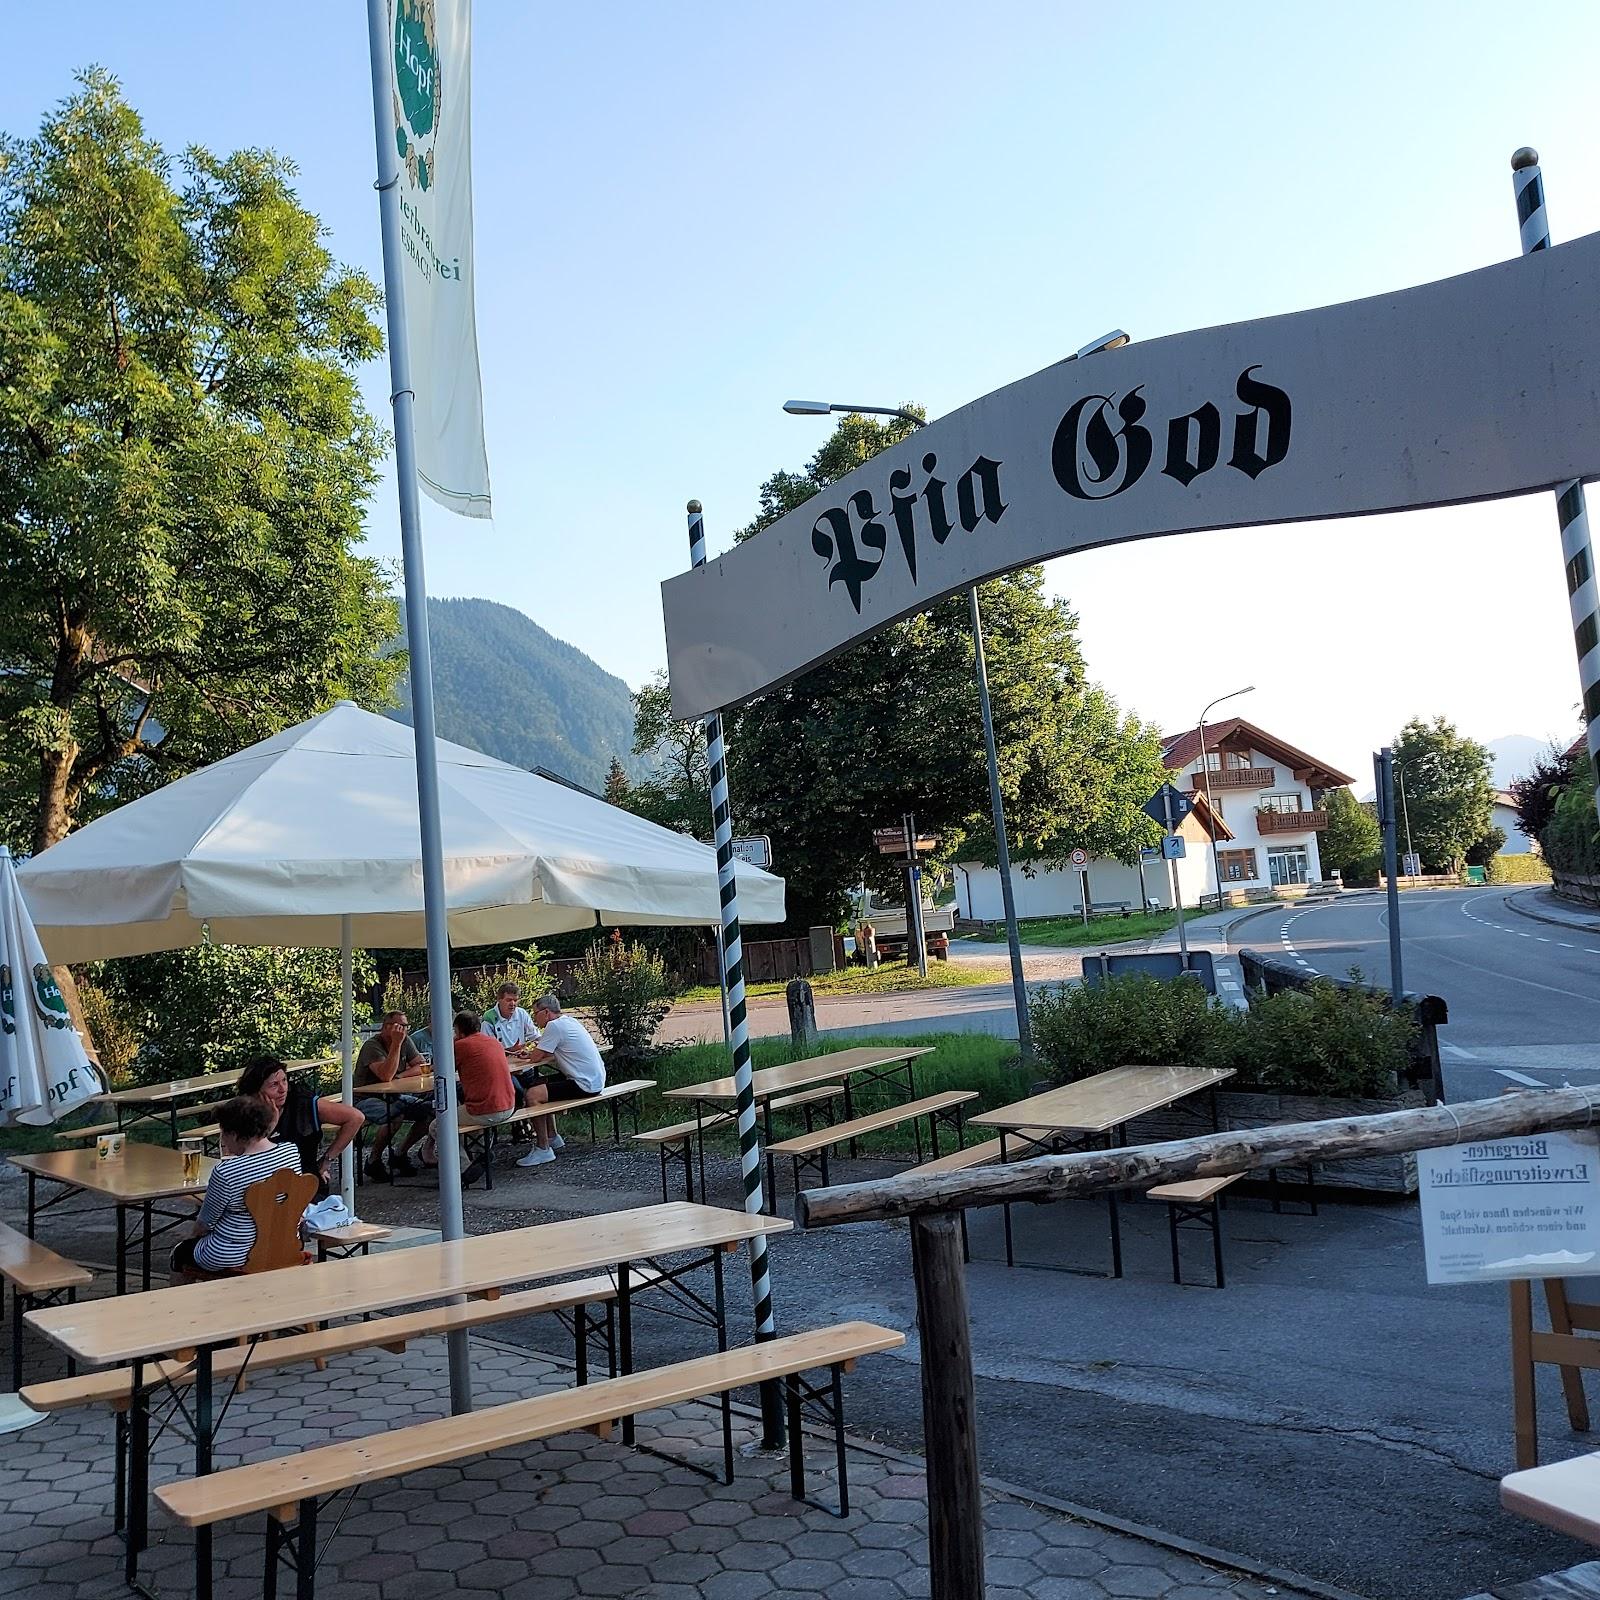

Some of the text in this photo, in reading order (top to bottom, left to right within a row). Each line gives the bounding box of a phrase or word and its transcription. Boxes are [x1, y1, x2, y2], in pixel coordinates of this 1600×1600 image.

[400, 21, 433, 98] Hopf
[811, 364, 1292, 615] Pfia God
